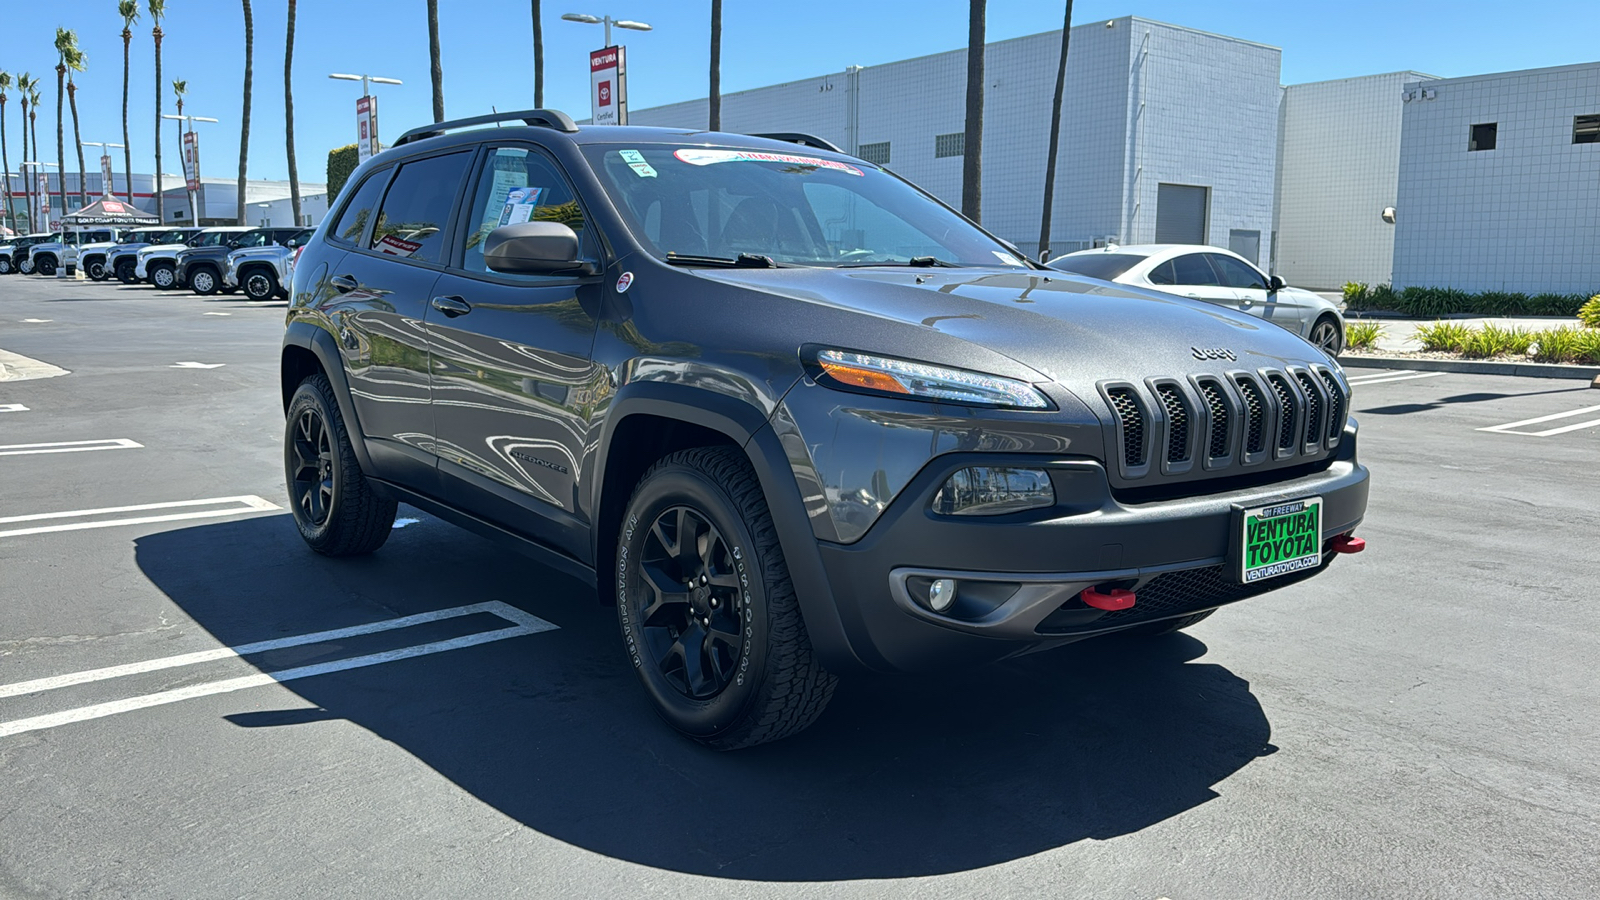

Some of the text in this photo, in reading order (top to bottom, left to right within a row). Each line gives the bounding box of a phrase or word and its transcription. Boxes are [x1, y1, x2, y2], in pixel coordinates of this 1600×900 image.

[591, 53, 617, 67] VENTURA
[1190, 346, 1238, 362] Jeep
[1263, 502, 1304, 517] 101 FREEWAY
[1248, 512, 1315, 545] VENTURA
[1249, 533, 1314, 566] TOYOTA
[1246, 556, 1318, 581] VENTURATOYOTA.COM
[617, 513, 642, 668] DESTINATION A/T
